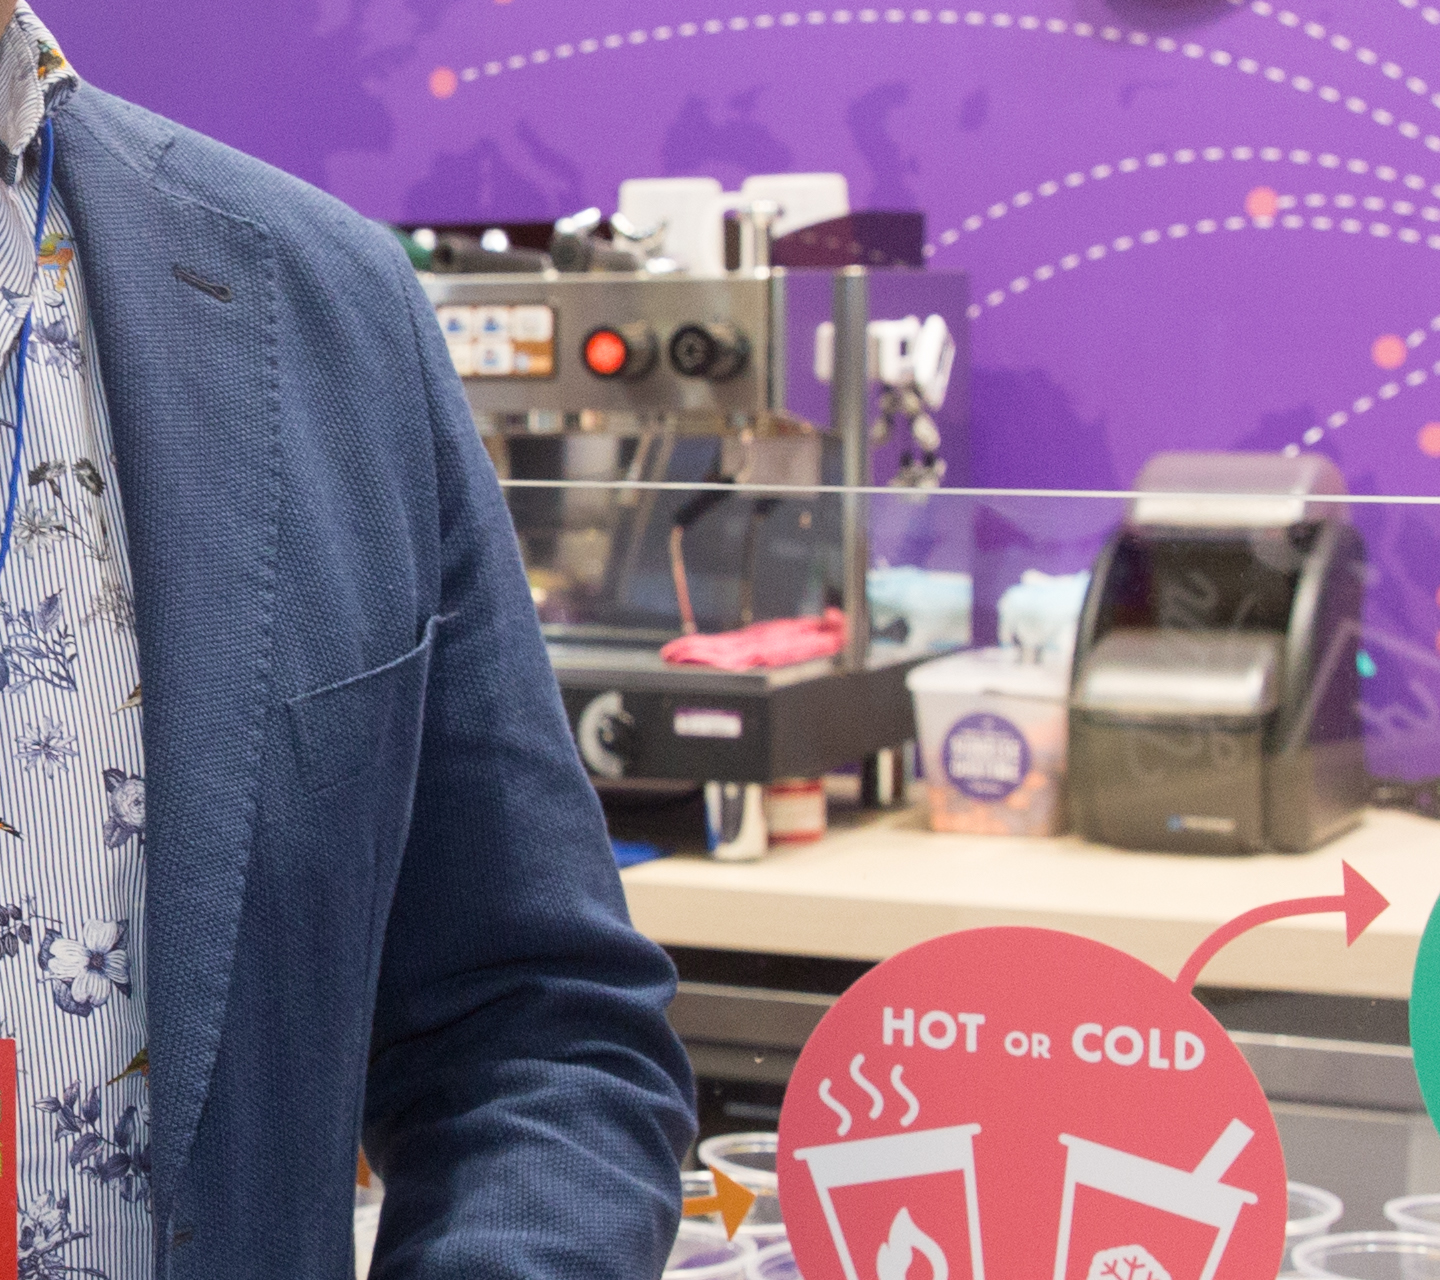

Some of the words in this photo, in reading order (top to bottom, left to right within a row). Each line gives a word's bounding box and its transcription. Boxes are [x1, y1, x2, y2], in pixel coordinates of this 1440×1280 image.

[882, 1007, 986, 1055] HOT
[1005, 1031, 1050, 1059] OR
[1072, 1022, 1206, 1072] COLD
